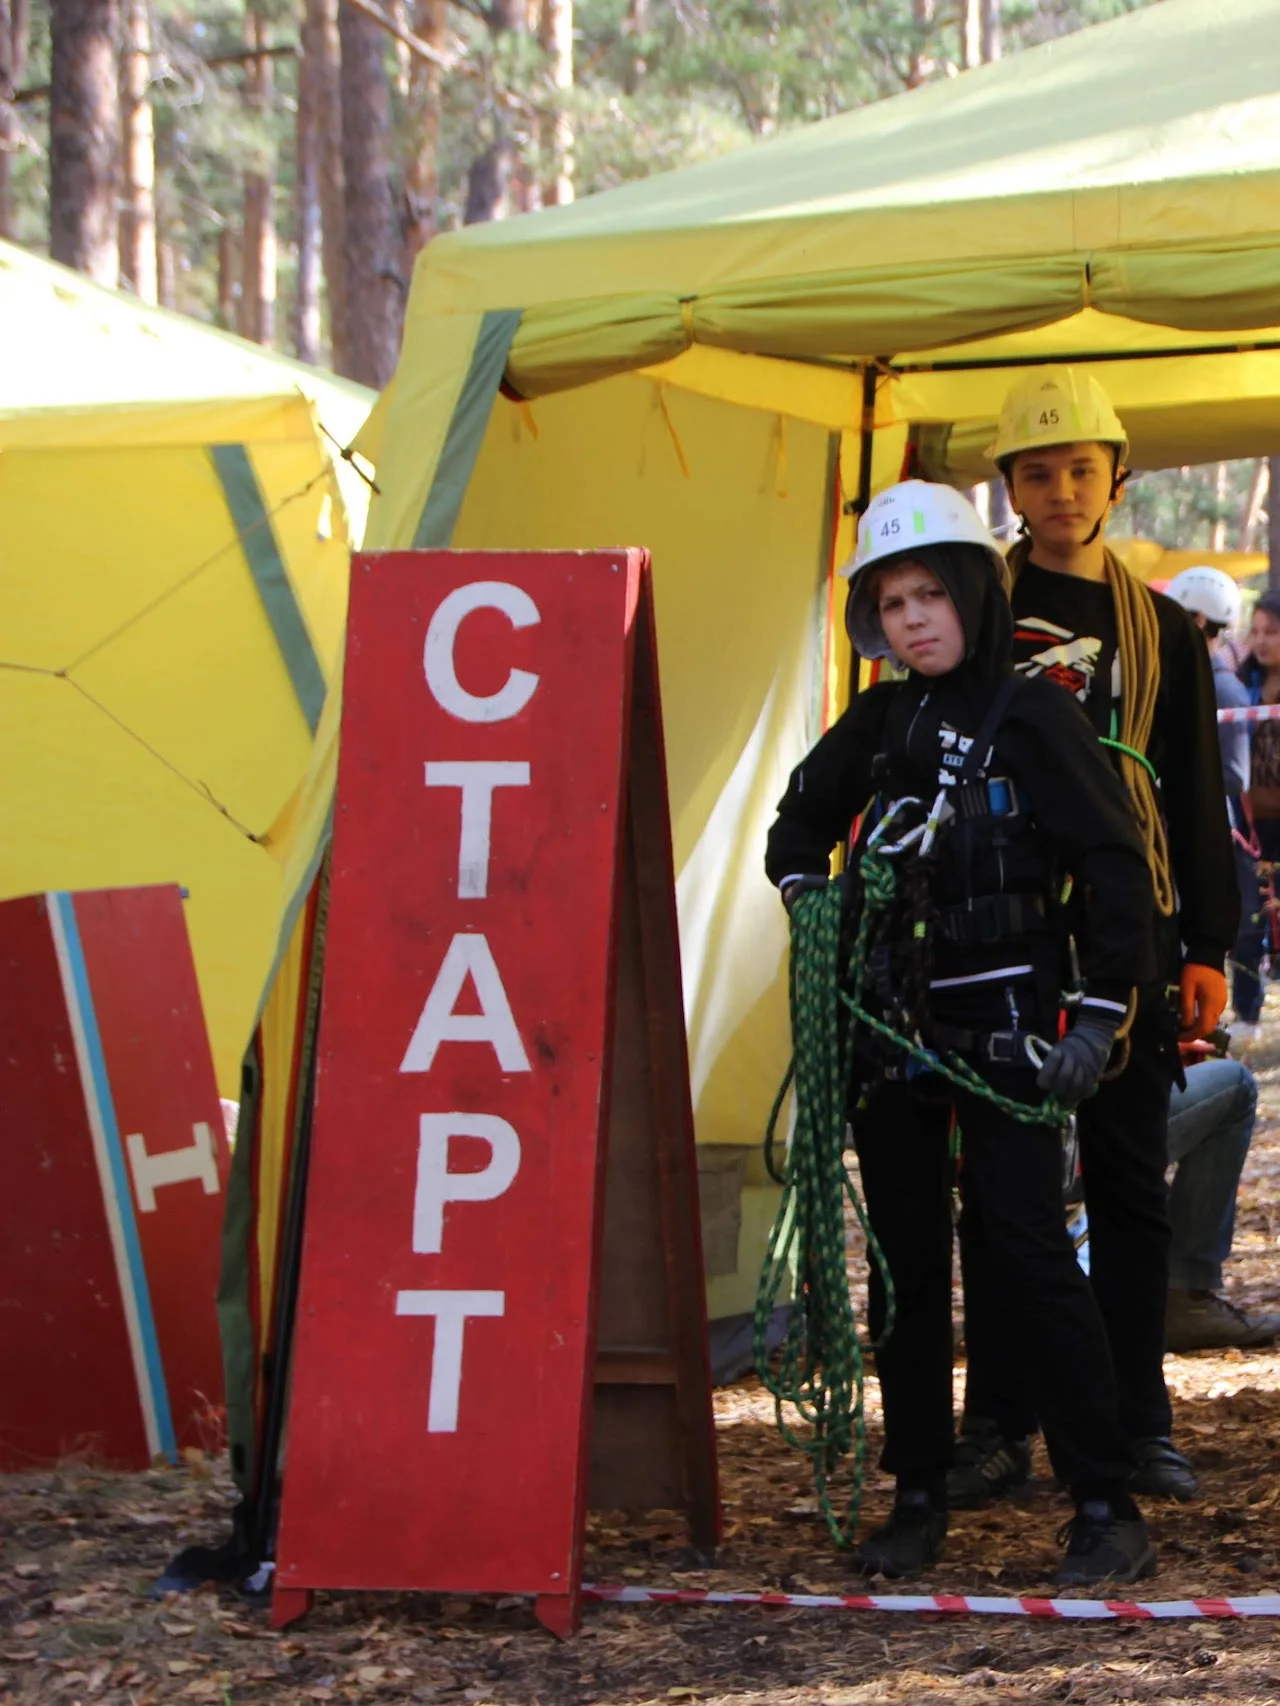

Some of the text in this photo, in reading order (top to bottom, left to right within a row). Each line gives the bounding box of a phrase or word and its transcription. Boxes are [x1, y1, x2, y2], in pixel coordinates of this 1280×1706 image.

[1039, 408, 1059, 426] 45
[880, 518, 900, 537] 45
[396, 581, 540, 1432] СТАРТ
